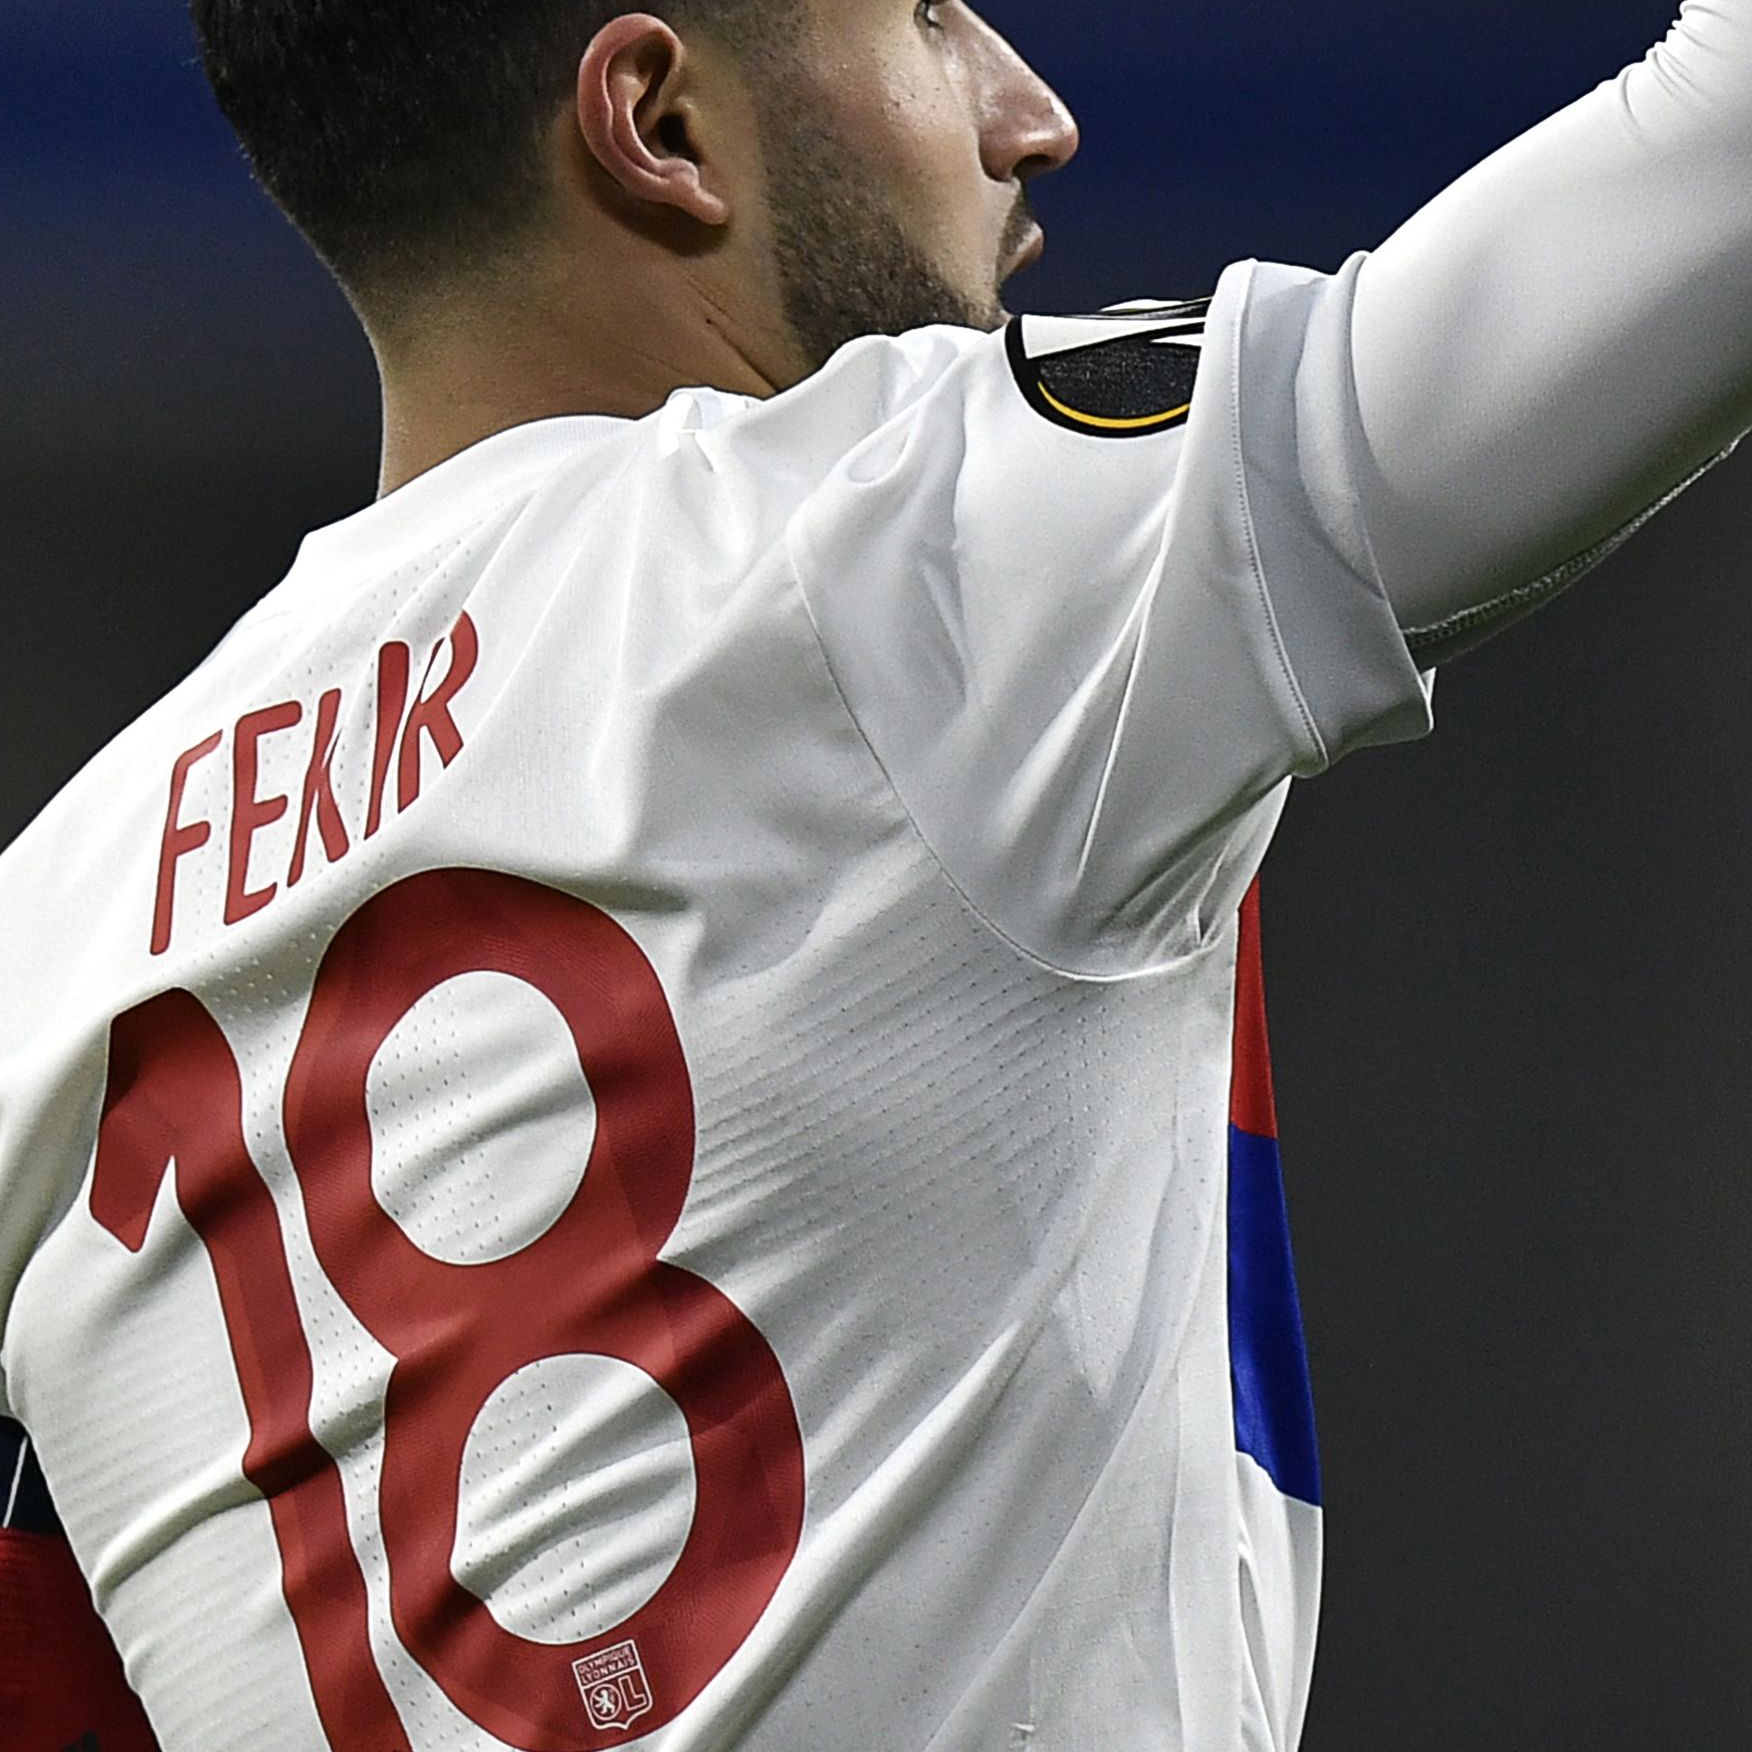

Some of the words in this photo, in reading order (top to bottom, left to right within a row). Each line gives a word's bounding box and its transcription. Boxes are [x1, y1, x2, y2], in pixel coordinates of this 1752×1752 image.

[150, 609, 479, 956] FEKIR
[89, 865, 806, 1752] 18
[580, 1655, 636, 1685] LYONNAIS
